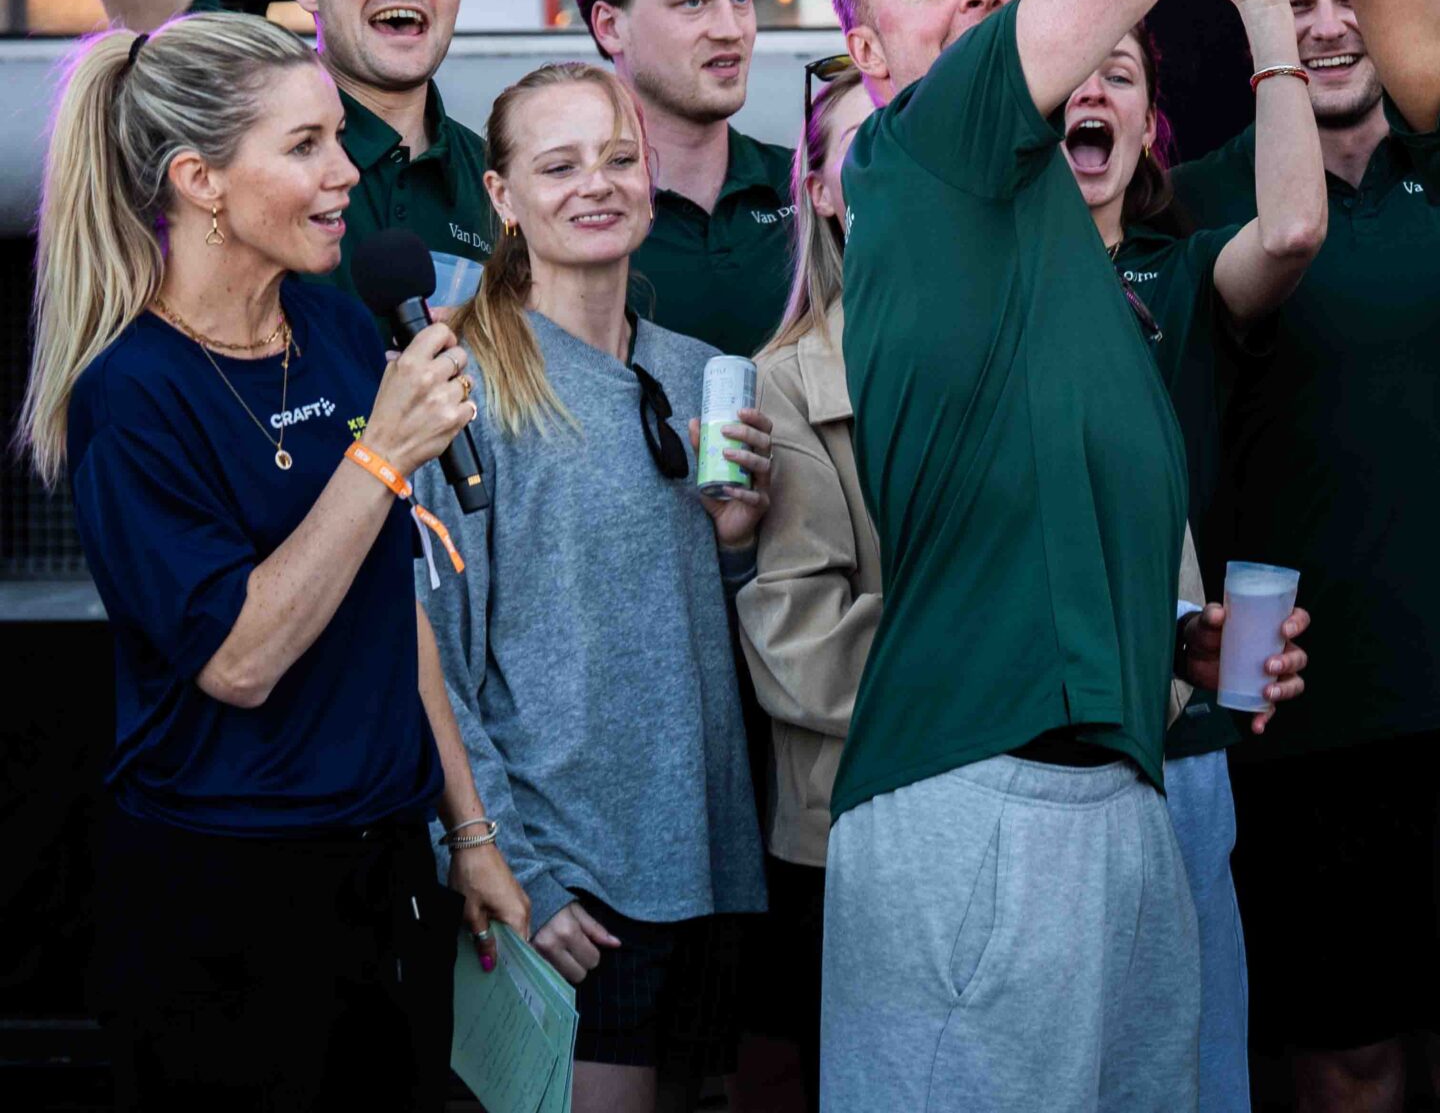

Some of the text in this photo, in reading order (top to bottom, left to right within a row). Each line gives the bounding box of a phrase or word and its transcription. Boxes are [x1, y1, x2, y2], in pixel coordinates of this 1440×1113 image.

[1403, 181, 1424, 194] Va
[751, 209, 777, 224] Van
[448, 222, 470, 243] Van
[270, 402, 321, 429] CRAFT
